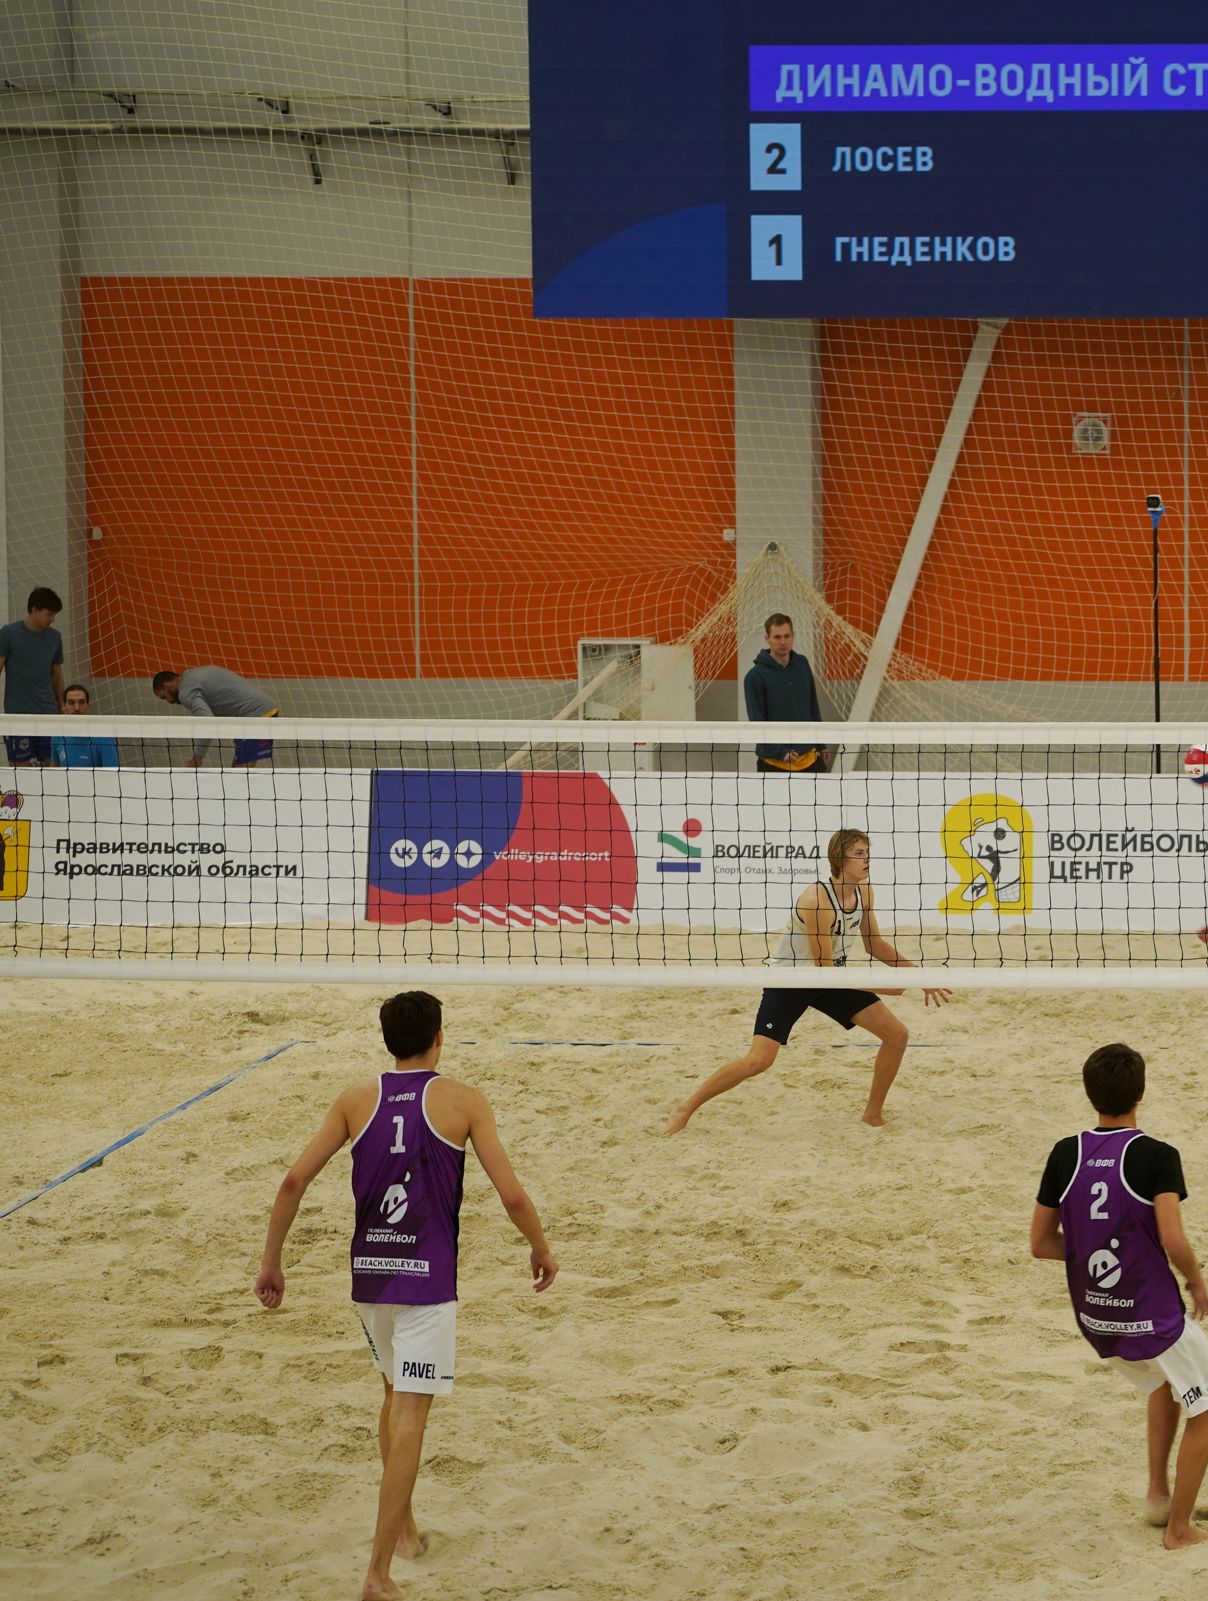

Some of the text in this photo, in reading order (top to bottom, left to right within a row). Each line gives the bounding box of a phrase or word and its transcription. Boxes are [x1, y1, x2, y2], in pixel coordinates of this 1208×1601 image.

[776, 58, 1149, 102] ДИНАМО-ВОДНЫЙ
[764, 142, 788, 175] 2
[832, 146, 935, 172] ЛОСЕВ
[767, 235, 785, 266] 1
[834, 236, 1016, 267] ГНЕДЕНКОВ
[55, 838, 225, 857] Правительство
[493, 849, 611, 863] volleygradresort
[715, 842, 821, 859] ВОЛЕЙГРАД
[54, 860, 298, 879] Ярославской области
[1050, 861, 1134, 881] ЦЕНТР
[394, 1092, 416, 1102] ВФВ
[390, 1115, 406, 1154] 1
[1095, 1159, 1115, 1168] ВФВ
[1090, 1181, 1109, 1220] 2
[366, 1231, 417, 1244] ВОЛЕЙБОЛ
[360, 1259, 426, 1270] BEACH.VOLLEY.RU
[402, 1361, 436, 1379] PAVEL
